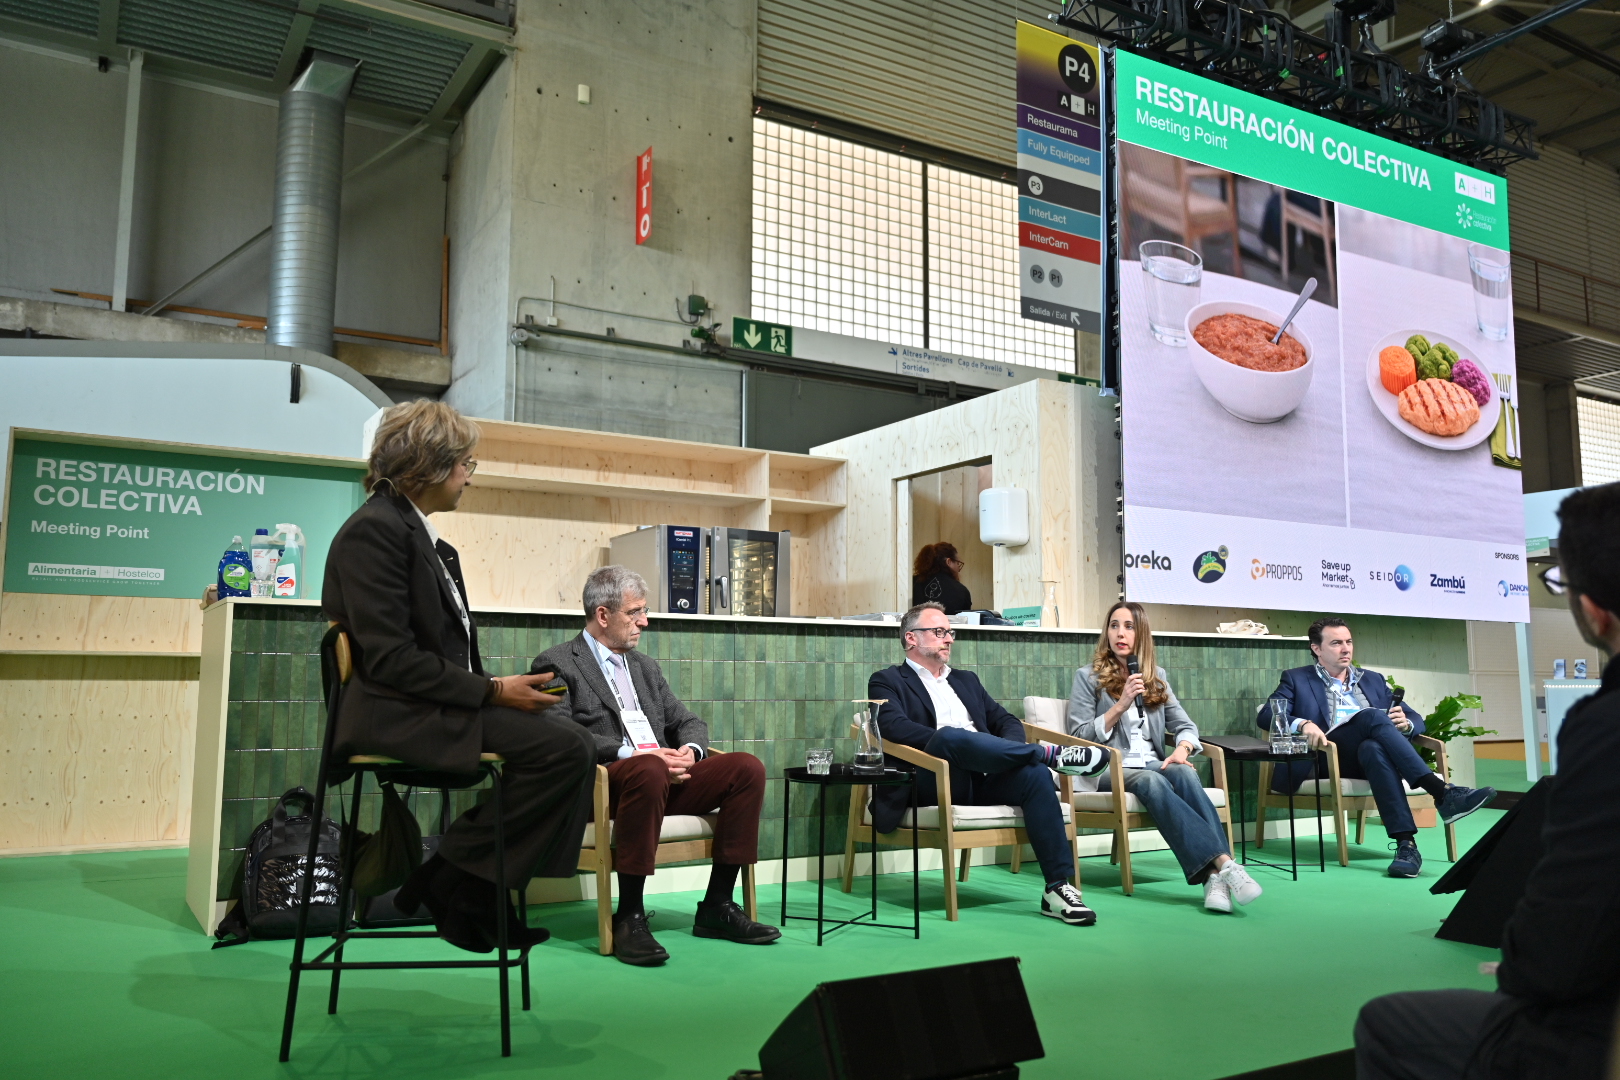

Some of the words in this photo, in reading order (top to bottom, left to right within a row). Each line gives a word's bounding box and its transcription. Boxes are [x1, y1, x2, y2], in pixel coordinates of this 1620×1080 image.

[1066, 56, 1090, 82] P4
[1060, 95, 1068, 107] A
[1088, 104, 1095, 116] H
[1028, 114, 1078, 138] Restaurama
[1136, 108, 1190, 142] Meeting
[1195, 126, 1228, 149] Point
[1136, 76, 1314, 154] RESTAURACIÓN
[1322, 137, 1431, 191] COLECTIVA
[1028, 138, 1048, 154] Fully
[1050, 146, 1090, 165] Equipped
[1030, 181, 1040, 190] P3
[1459, 178, 1465, 191] A
[1485, 186, 1491, 199] H
[1028, 206, 1066, 224] InterLact
[1473, 220, 1492, 231] colectiva
[1030, 231, 1069, 250] InterCarn
[1032, 270, 1042, 279] P2
[1051, 274, 1060, 283] P1
[1030, 306, 1050, 317] Salida
[1056, 311, 1067, 320] Exit
[902, 349, 922, 359] Altres
[924, 352, 953, 364] Pavellons
[902, 362, 930, 373] Sortides
[958, 359, 969, 368] Cap
[980, 362, 1002, 372] Pavelló
[36, 458, 265, 494] RESTAURACIÓN
[34, 484, 202, 515] COLECTIVA
[31, 520, 100, 538] Meeting
[106, 524, 150, 538] Point
[1495, 552, 1519, 560] SPONSORS
[32, 565, 96, 576] Alimentaria
[118, 569, 160, 578] Hostelco
[1266, 564, 1302, 581] PROPPOS
[1322, 560, 1340, 570] Save
[1341, 563, 1351, 572] up
[1322, 571, 1349, 582] Market
[1370, 571, 1409, 582] SEIDOR
[1430, 574, 1465, 589] Zambú
